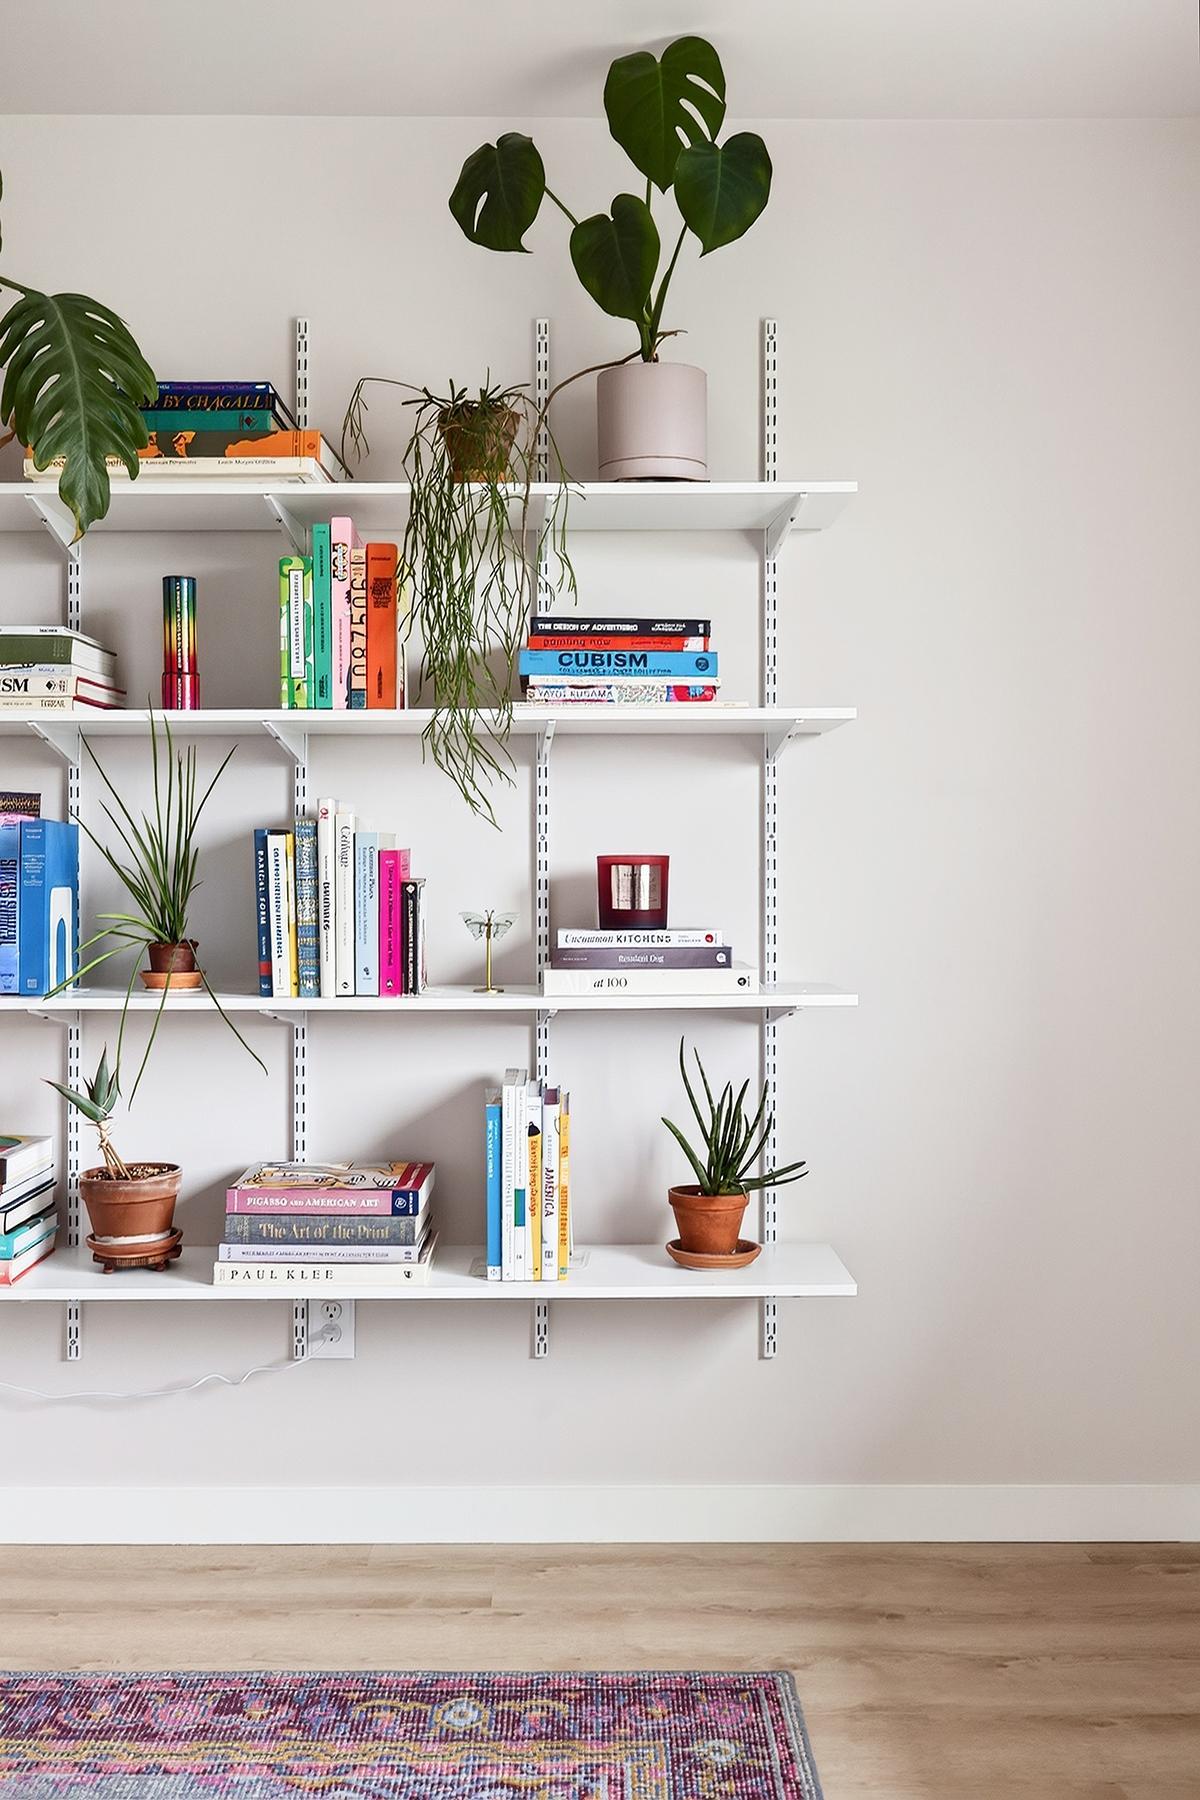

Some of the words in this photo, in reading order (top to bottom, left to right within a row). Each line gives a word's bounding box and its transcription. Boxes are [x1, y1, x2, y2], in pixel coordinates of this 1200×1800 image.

[163, 395, 183, 407] BY
[186, 395, 264, 410] CHAGALL
[553, 623, 579, 631] DESIGN
[543, 638, 586, 648] painting
[558, 652, 648, 668] CUBISM
[0, 678, 29, 692] SM
[538, 688, 566, 698] YAYOI
[570, 688, 614, 699] KUSAMA
[565, 933, 614, 944] Uncommon
[616, 934, 672, 943] KITCHENS
[618, 954, 649, 963] Resident
[593, 979, 604, 988] at
[607, 978, 628, 988] 100
[544, 1167, 555, 1218] AMERICA
[246, 1197, 288, 1207] PICASSO
[305, 1198, 357, 1207] AMERICAN
[359, 1199, 380, 1208] ART
[259, 1223, 286, 1239] The
[291, 1223, 310, 1239] Art
[313, 1223, 329, 1239] of
[333, 1224, 355, 1240] the
[357, 1224, 391, 1240] Print
[231, 1269, 278, 1280] PAUL
[286, 1269, 334, 1280] KLEE
